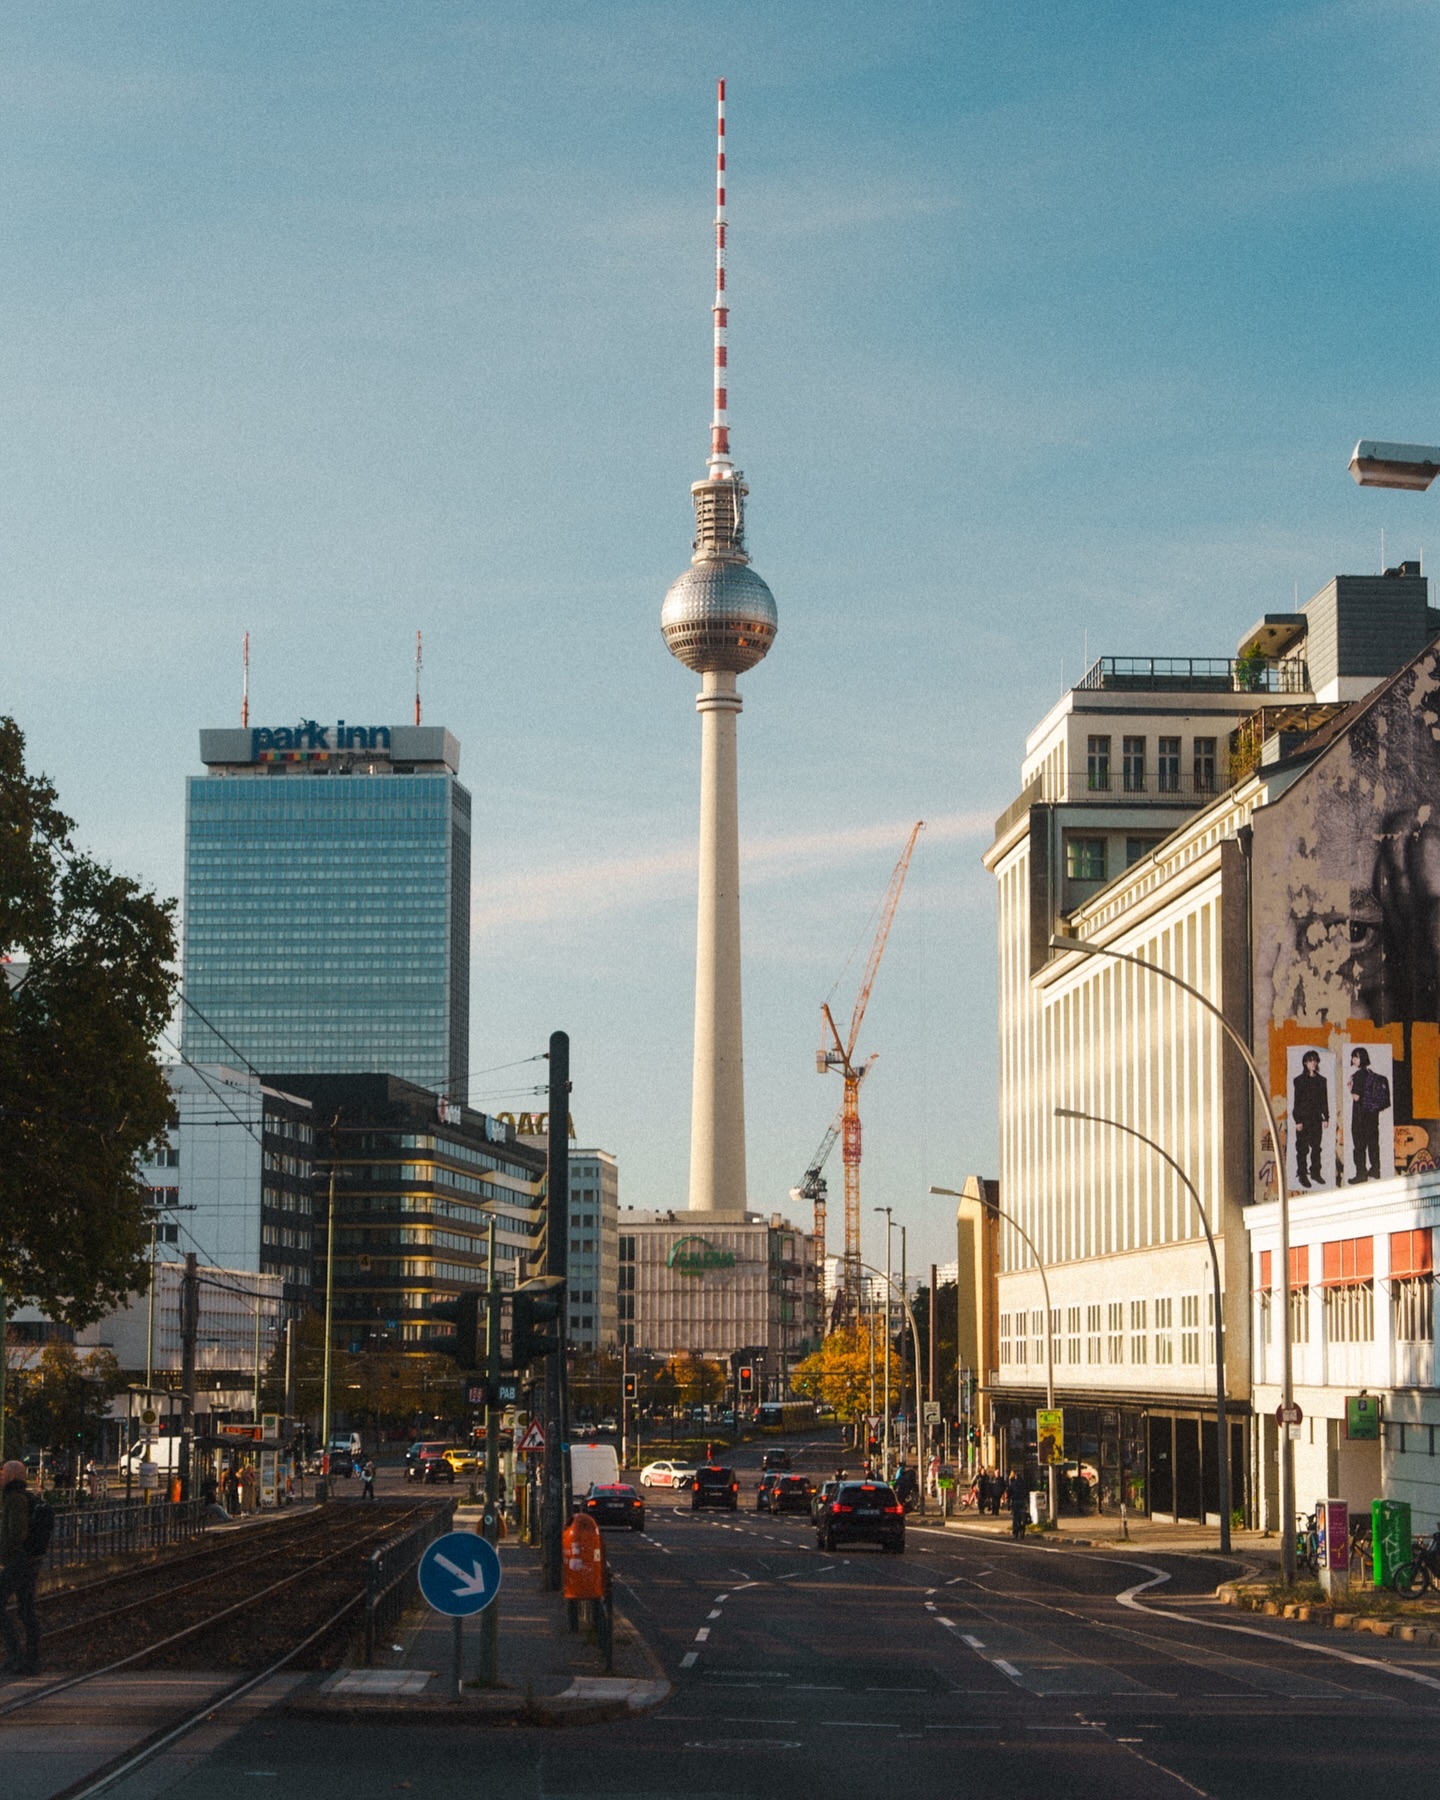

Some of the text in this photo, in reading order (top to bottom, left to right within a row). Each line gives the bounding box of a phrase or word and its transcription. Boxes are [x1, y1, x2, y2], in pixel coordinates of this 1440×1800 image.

[252, 720, 390, 760] park inn
[679, 1252, 736, 1268] GALERIA
[500, 1386, 516, 1399] PAB
